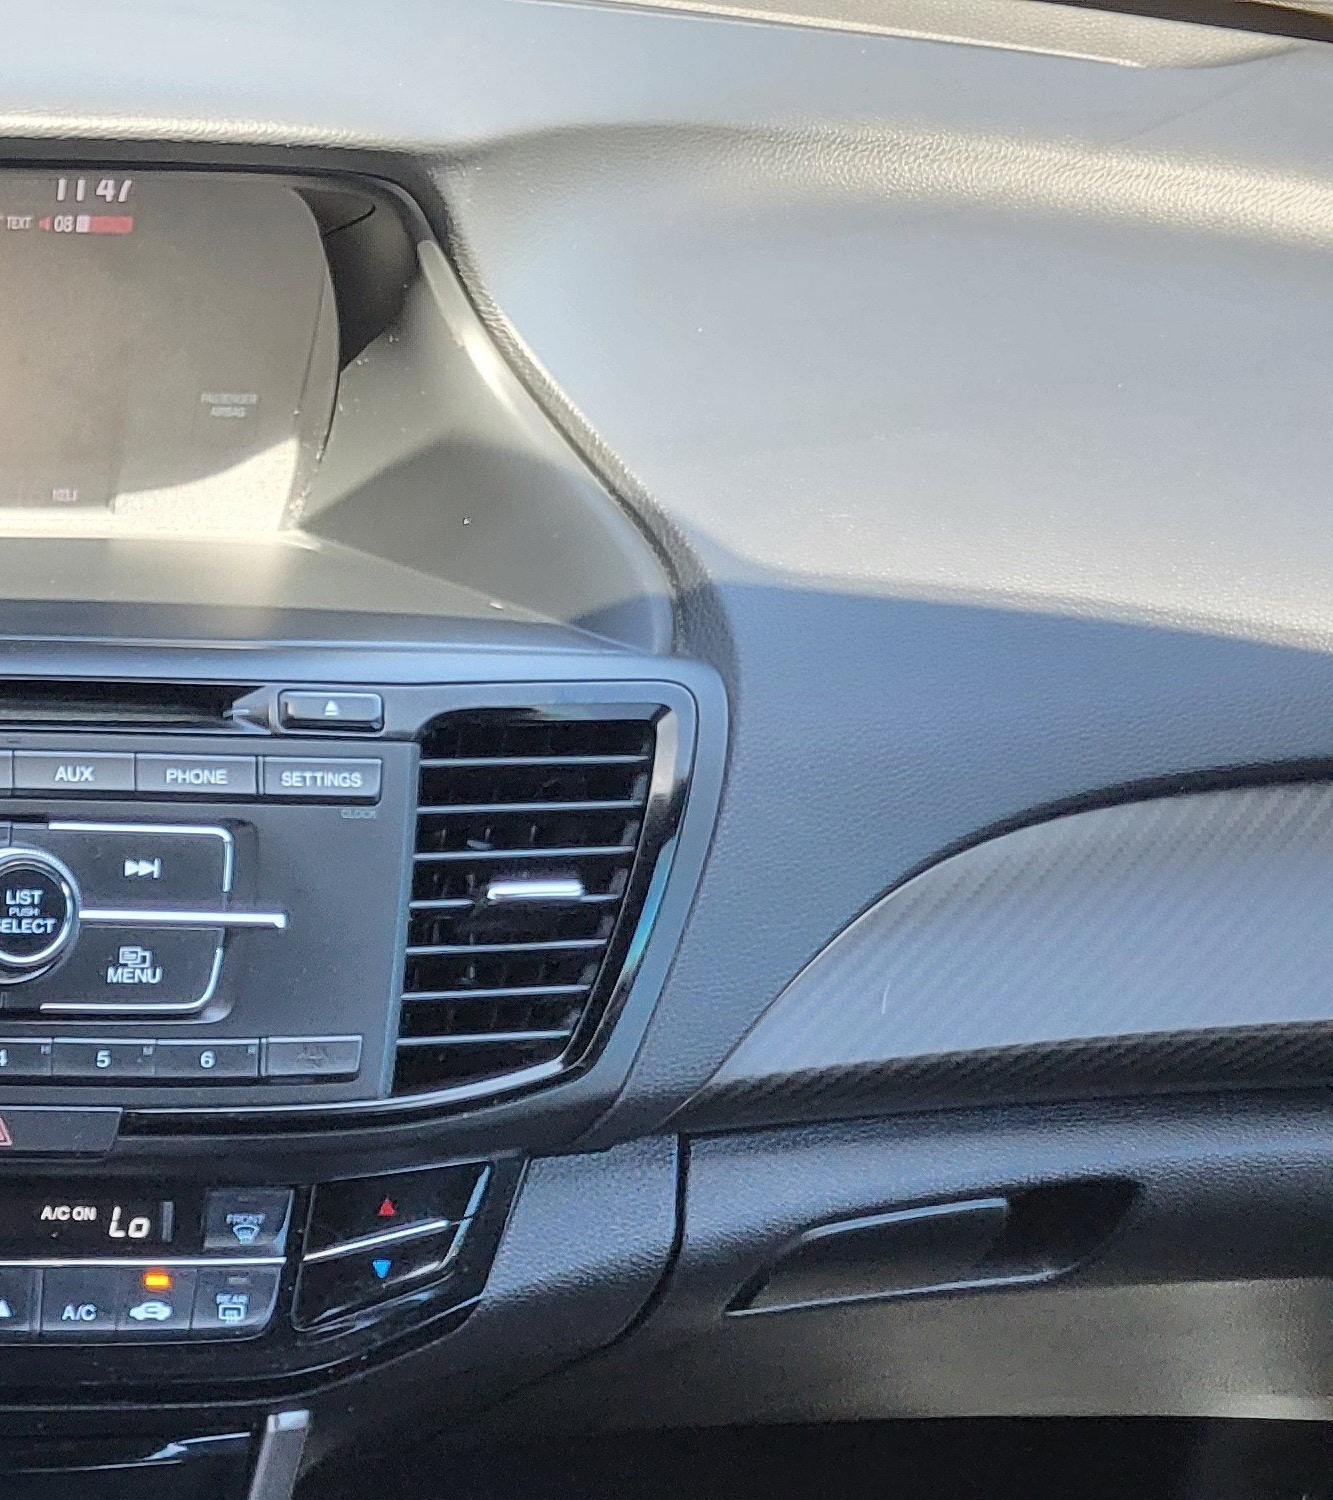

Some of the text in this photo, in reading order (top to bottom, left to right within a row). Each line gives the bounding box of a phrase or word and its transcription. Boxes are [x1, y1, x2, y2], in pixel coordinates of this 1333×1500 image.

[54, 765, 94, 782] AUX
[165, 768, 228, 785] PHONE
[281, 771, 362, 788] SETTINGS
[5, 889, 44, 906] LIST
[8, 907, 41, 918] PUSH
[106, 966, 163, 984] MENU
[96, 1050, 112, 1068] 5
[199, 1051, 216, 1069] 6
[72, 1206, 97, 1222] ON
[108, 1206, 151, 1240] Lo
[61, 1304, 97, 1322] A/C
